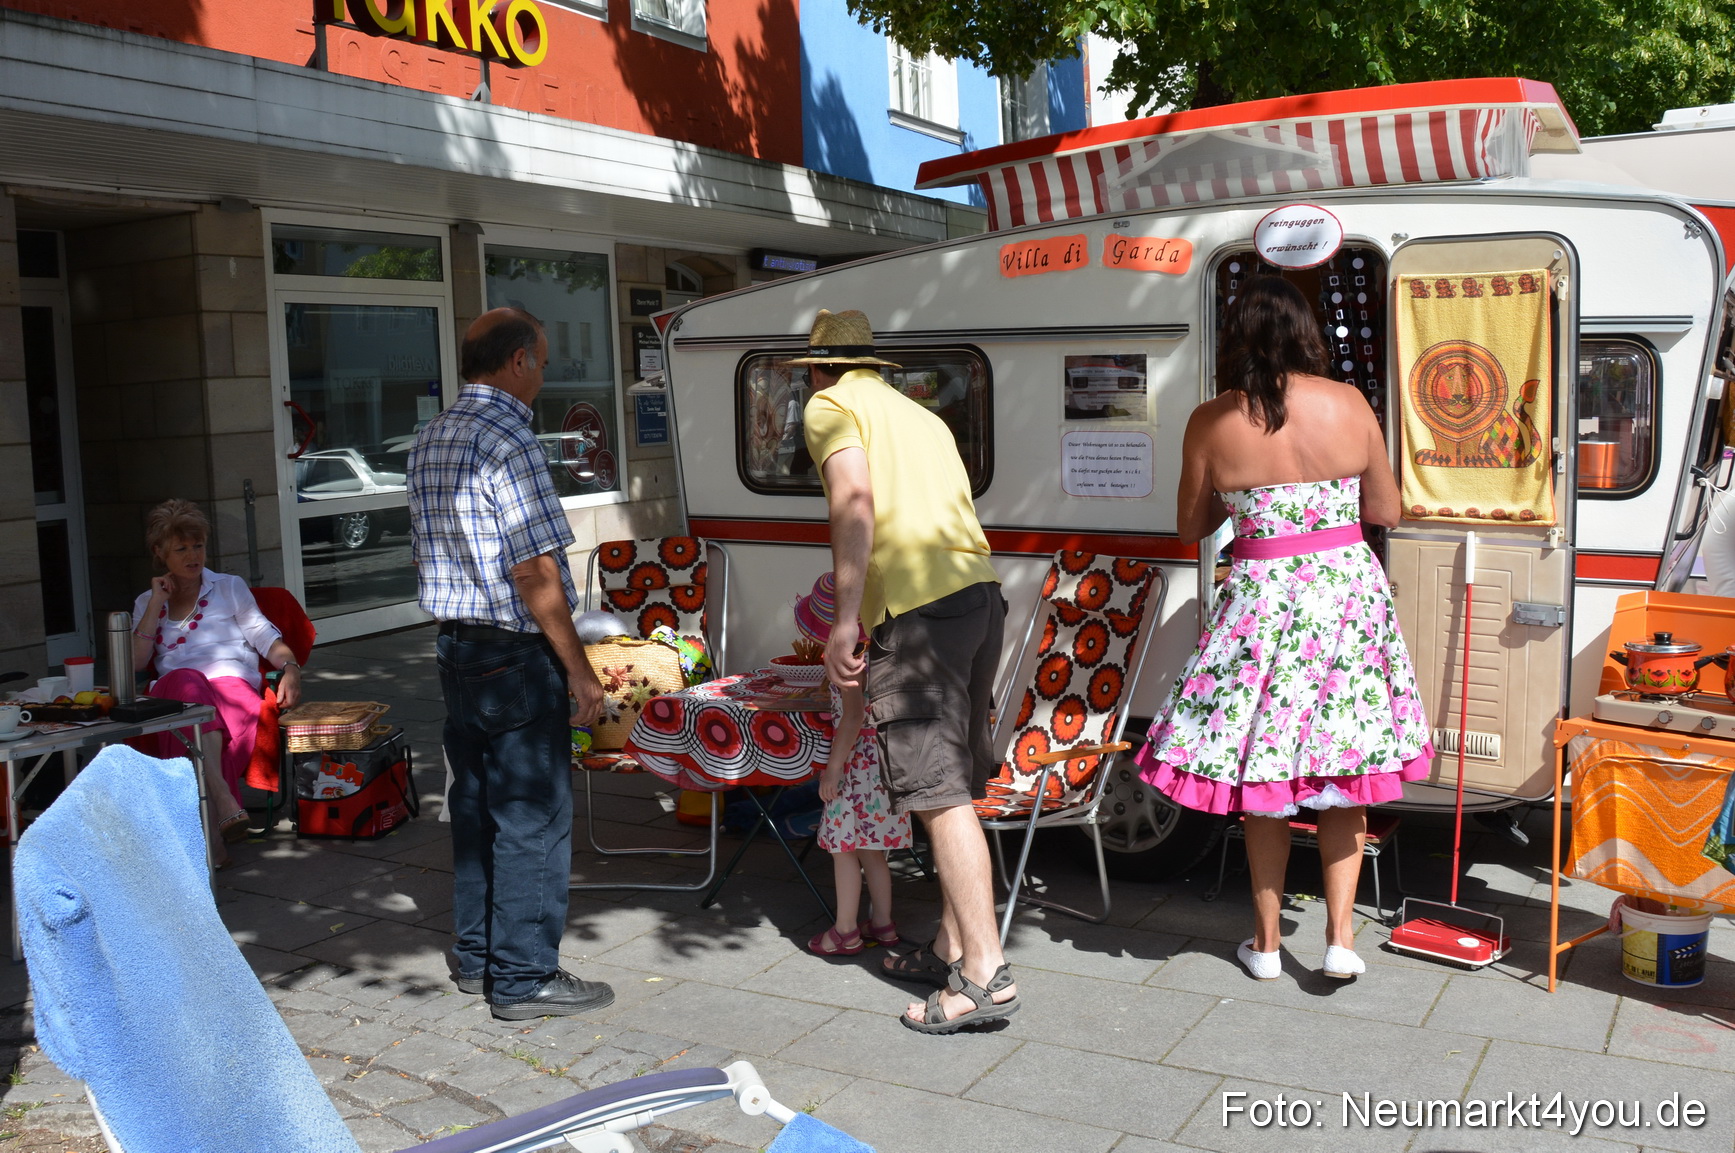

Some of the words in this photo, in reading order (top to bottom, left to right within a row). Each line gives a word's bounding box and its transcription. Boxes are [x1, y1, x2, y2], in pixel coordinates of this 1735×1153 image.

[1268, 218, 1325, 229] reinguggen
[1266, 241, 1318, 253] erwünscht
[1002, 247, 1050, 272] Villa
[1063, 242, 1082, 265] di
[1112, 239, 1180, 266] Garda
